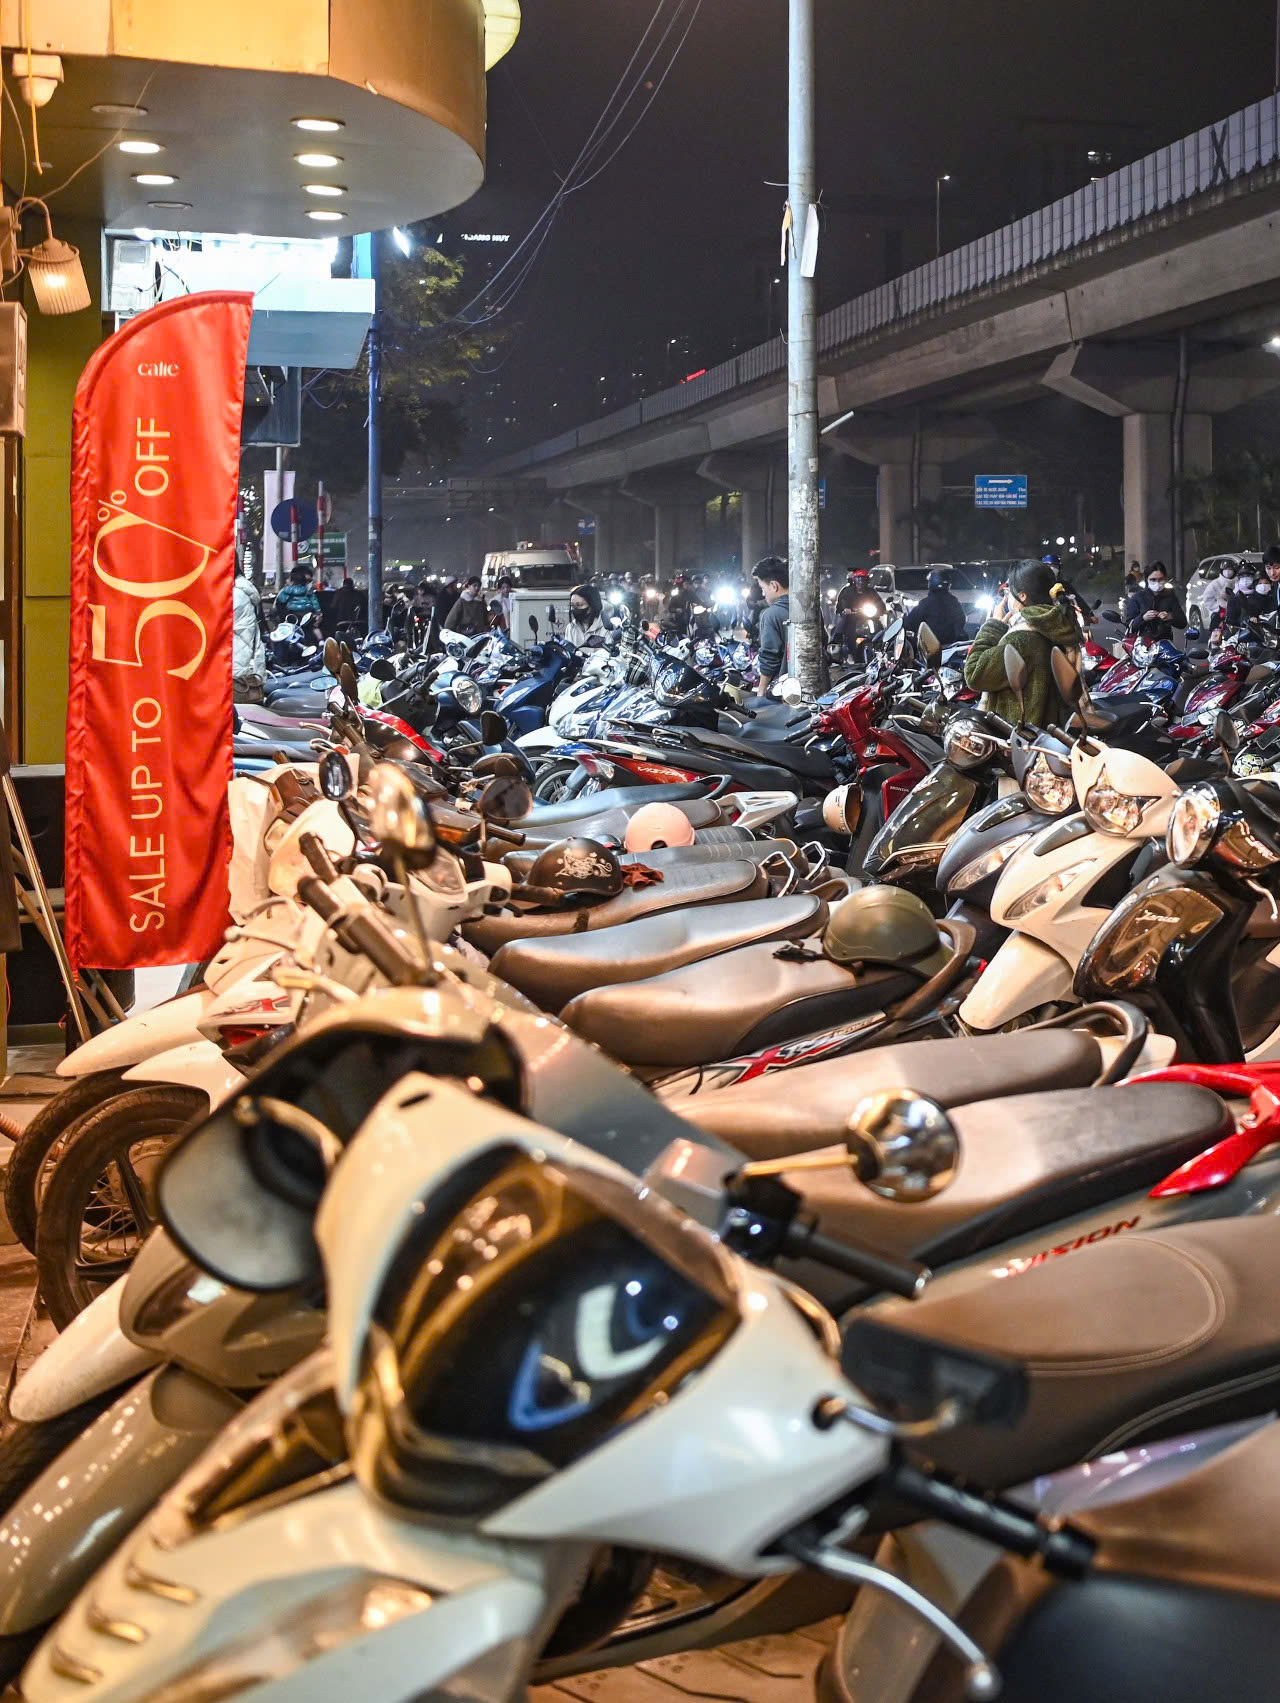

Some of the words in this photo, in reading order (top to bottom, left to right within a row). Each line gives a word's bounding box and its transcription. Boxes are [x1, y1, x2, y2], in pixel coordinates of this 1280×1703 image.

[134, 416, 171, 497] OFF
[88, 489, 218, 681] 50%
[131, 697, 163, 754] TO
[130, 765, 163, 819] UP
[129, 833, 166, 933] SALE
[1135, 909, 1181, 924] Janus
[992, 1215, 1142, 1279] VISION
